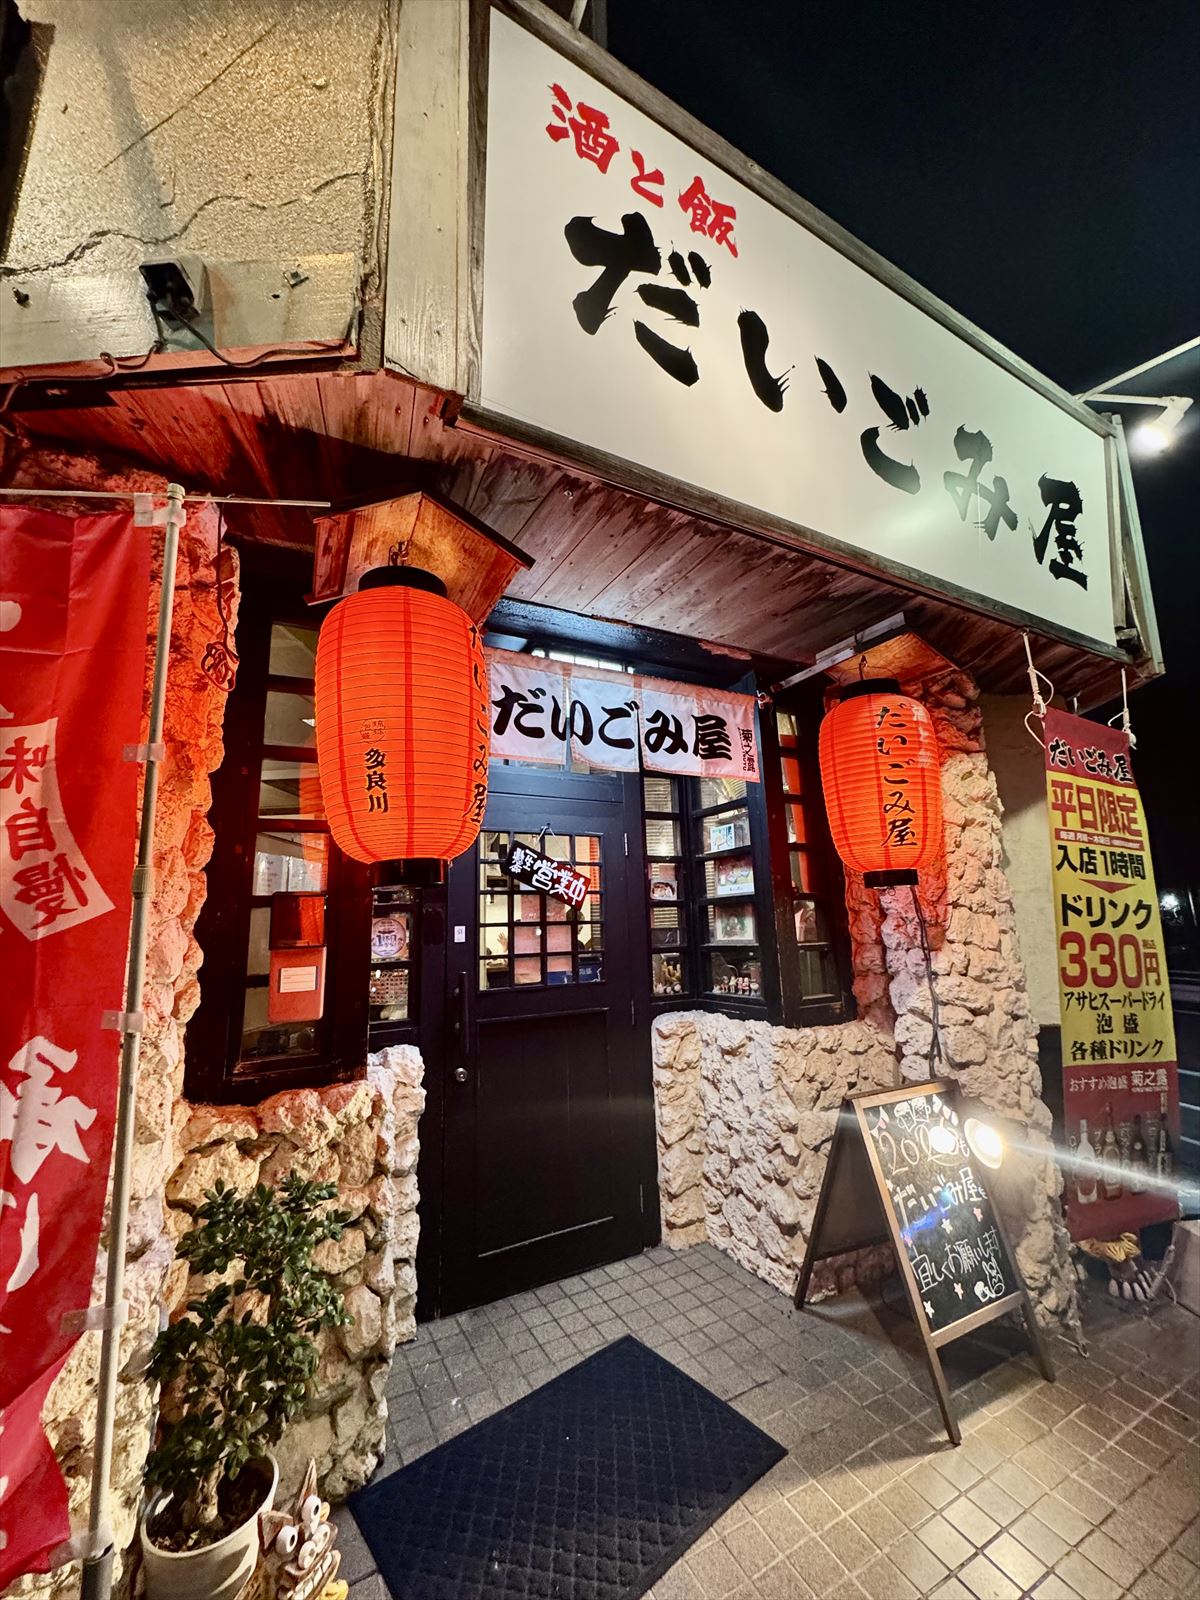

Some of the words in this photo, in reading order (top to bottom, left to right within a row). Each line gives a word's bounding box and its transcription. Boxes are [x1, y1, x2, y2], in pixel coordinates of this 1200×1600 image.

[545, 82, 739, 258] 酒と飯
[563, 211, 1088, 591] だいごみ屋
[492, 684, 733, 761] だいごみ屋
[364, 748, 388, 813] 多良川
[873, 702, 918, 848] だいごみ屋
[1048, 737, 1134, 783] だいごみ屋
[1051, 779, 1143, 837] 平日限定
[532, 860, 586, 905] 営業中
[1056, 844, 1146, 880] 入店1時間
[1061, 893, 1152, 930] ドリンク
[1064, 991, 1165, 1011] アサヒスーパードライ
[1070, 1039, 1164, 1061] 各種ドリンク
[1069, 1075, 1128, 1092] おすすめ泡盛
